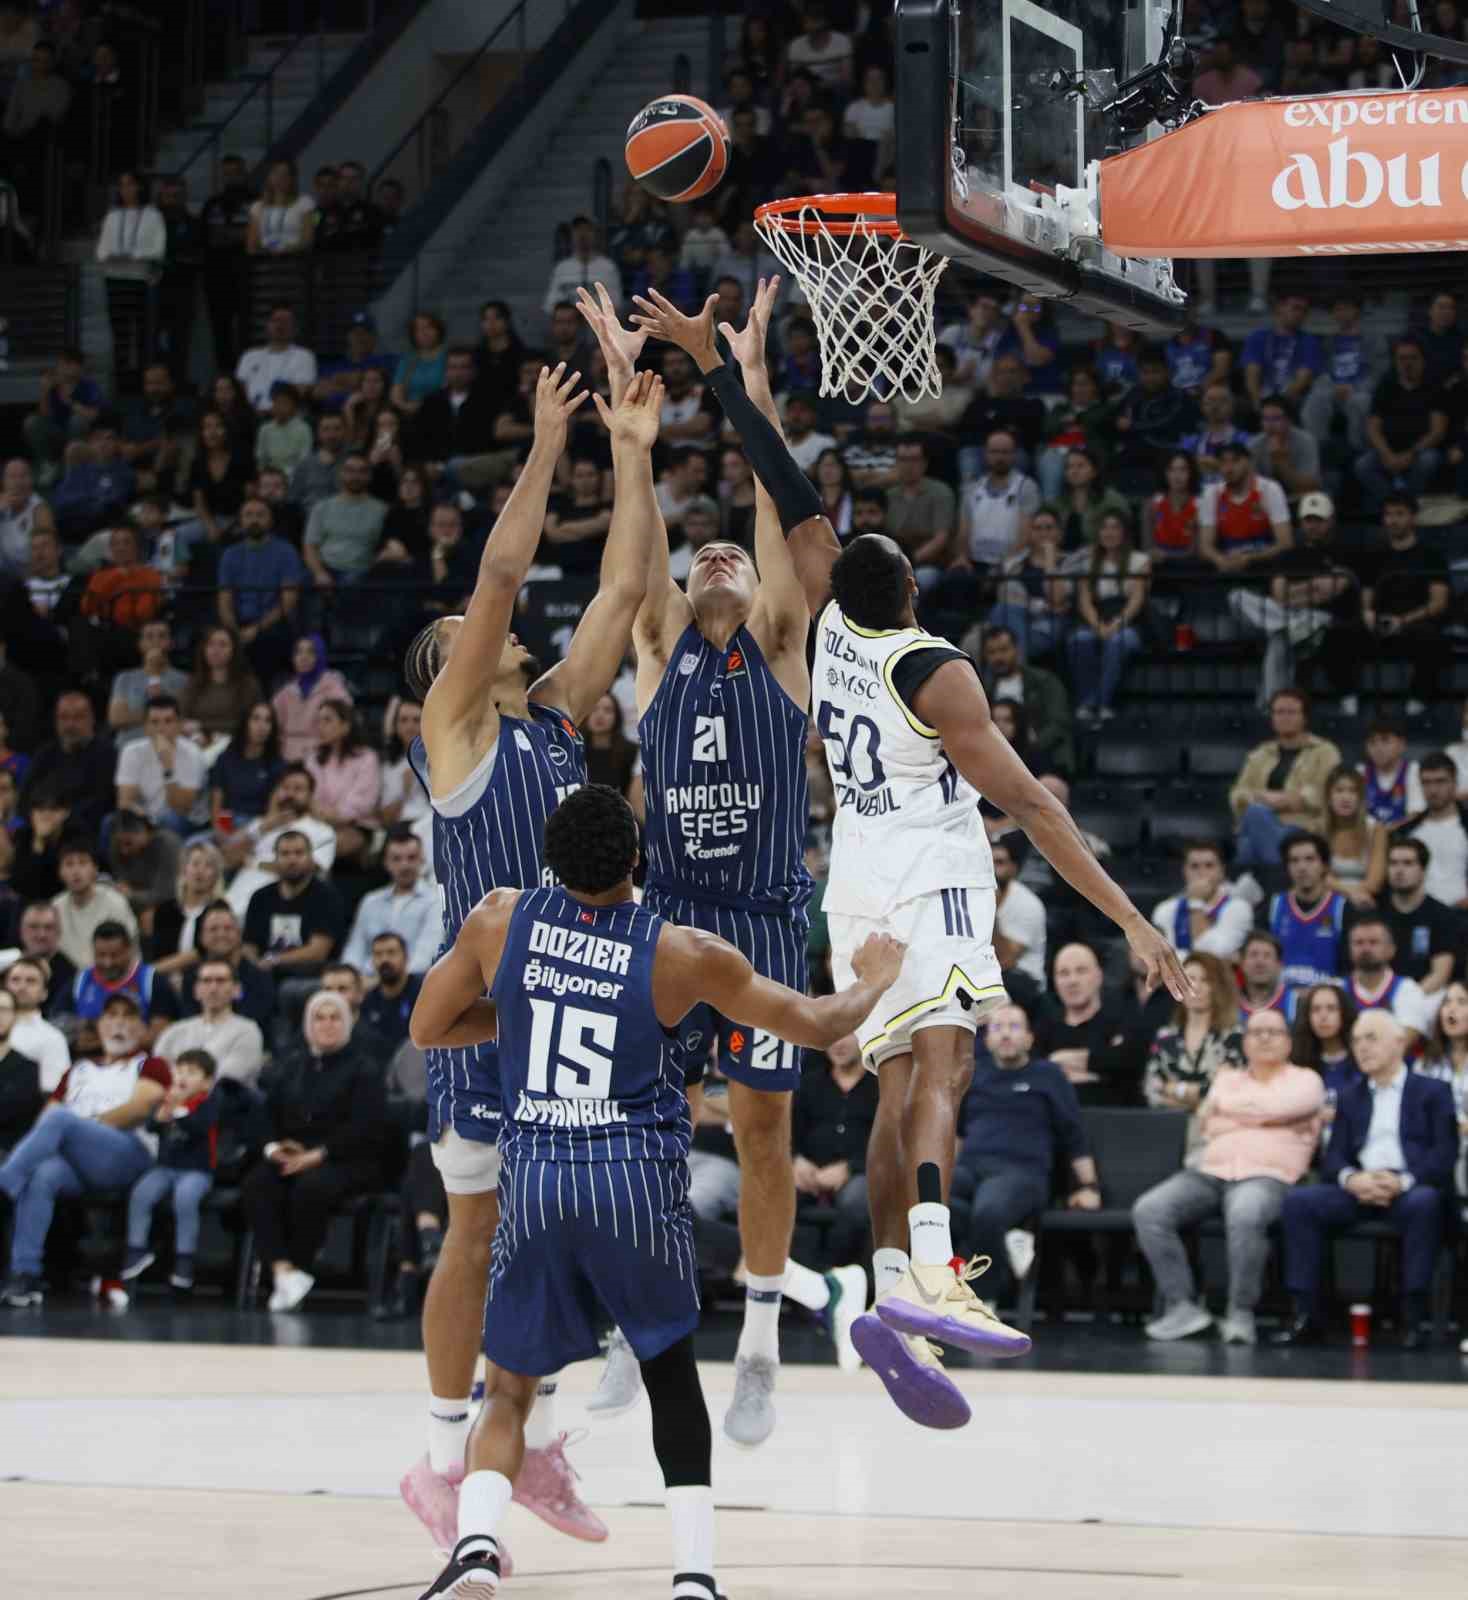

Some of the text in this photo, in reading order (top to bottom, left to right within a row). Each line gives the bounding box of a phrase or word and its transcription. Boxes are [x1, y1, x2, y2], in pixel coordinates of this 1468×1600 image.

[1271, 135, 1442, 211] abu
[840, 670, 880, 700] MSC
[692, 715, 727, 763] 21
[817, 700, 886, 791] 50
[680, 809, 748, 838] EFES
[528, 920, 633, 976] DOZIER
[522, 958, 624, 1000] Bilyoner
[526, 998, 618, 1100] 15
[751, 1027, 794, 1070] 21
